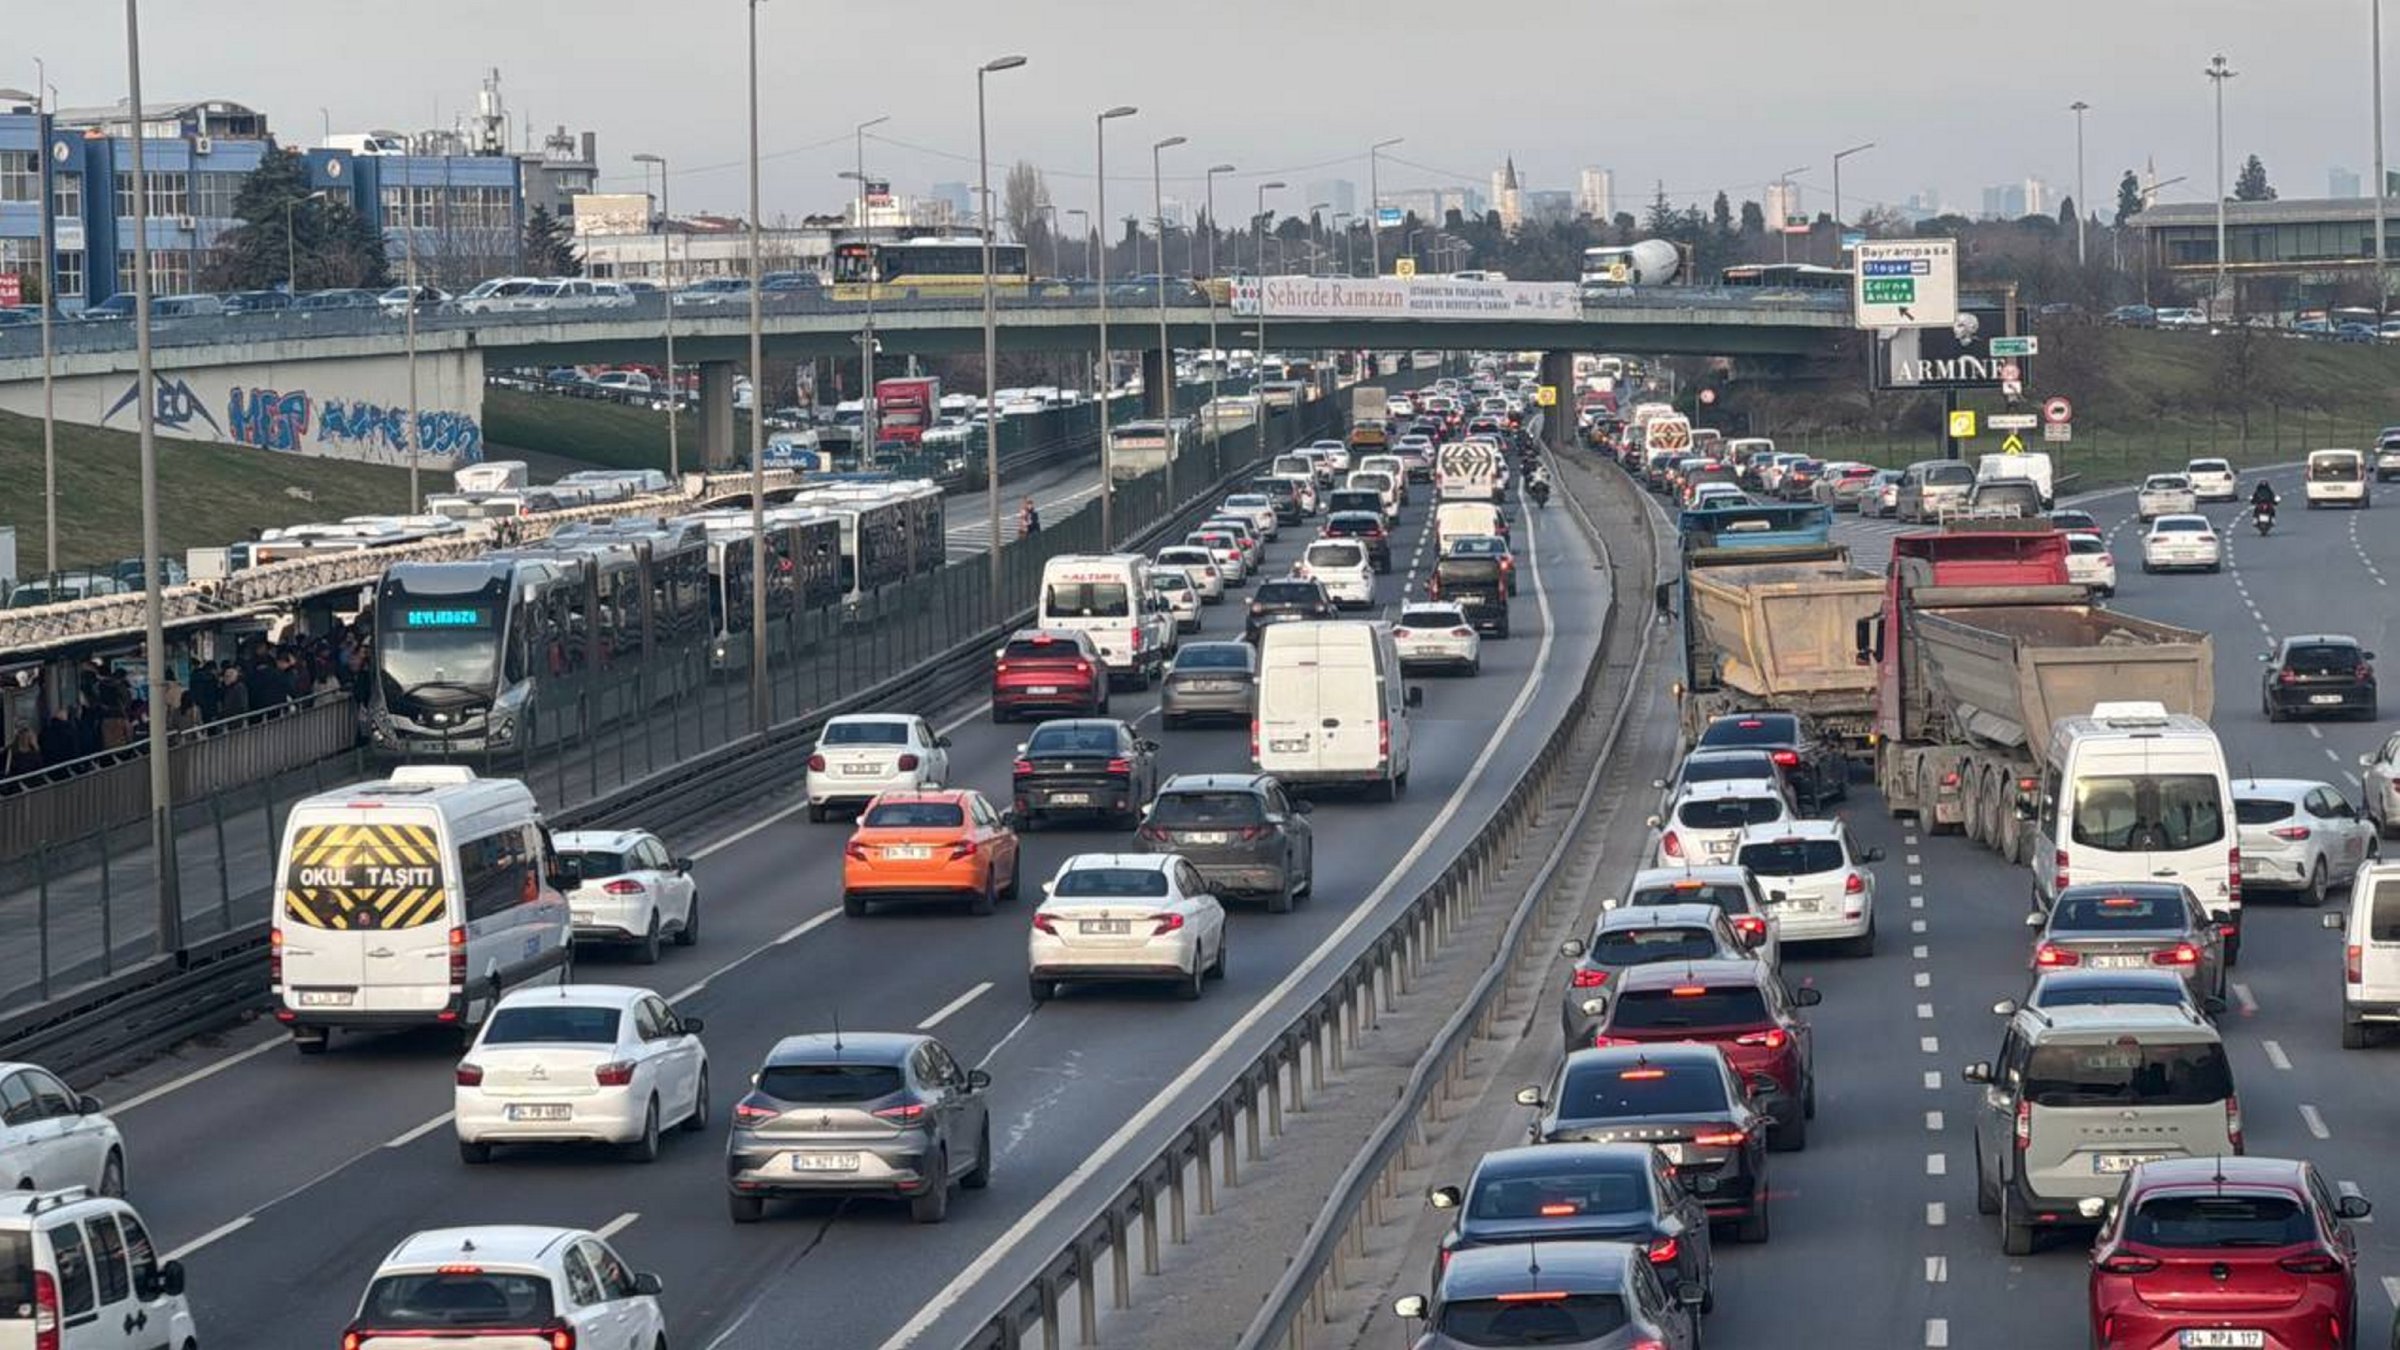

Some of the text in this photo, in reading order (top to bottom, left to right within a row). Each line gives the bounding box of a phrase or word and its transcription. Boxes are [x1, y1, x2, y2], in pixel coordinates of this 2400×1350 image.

[1865, 282, 1908, 291] Edirne
[1267, 281, 1404, 309] Şehirde Ramazan
[1866, 293, 1912, 302] Ankara
[299, 868, 434, 890] OKUL TAŞITI
[2188, 1332, 2260, 1345] 34 MPA 117
